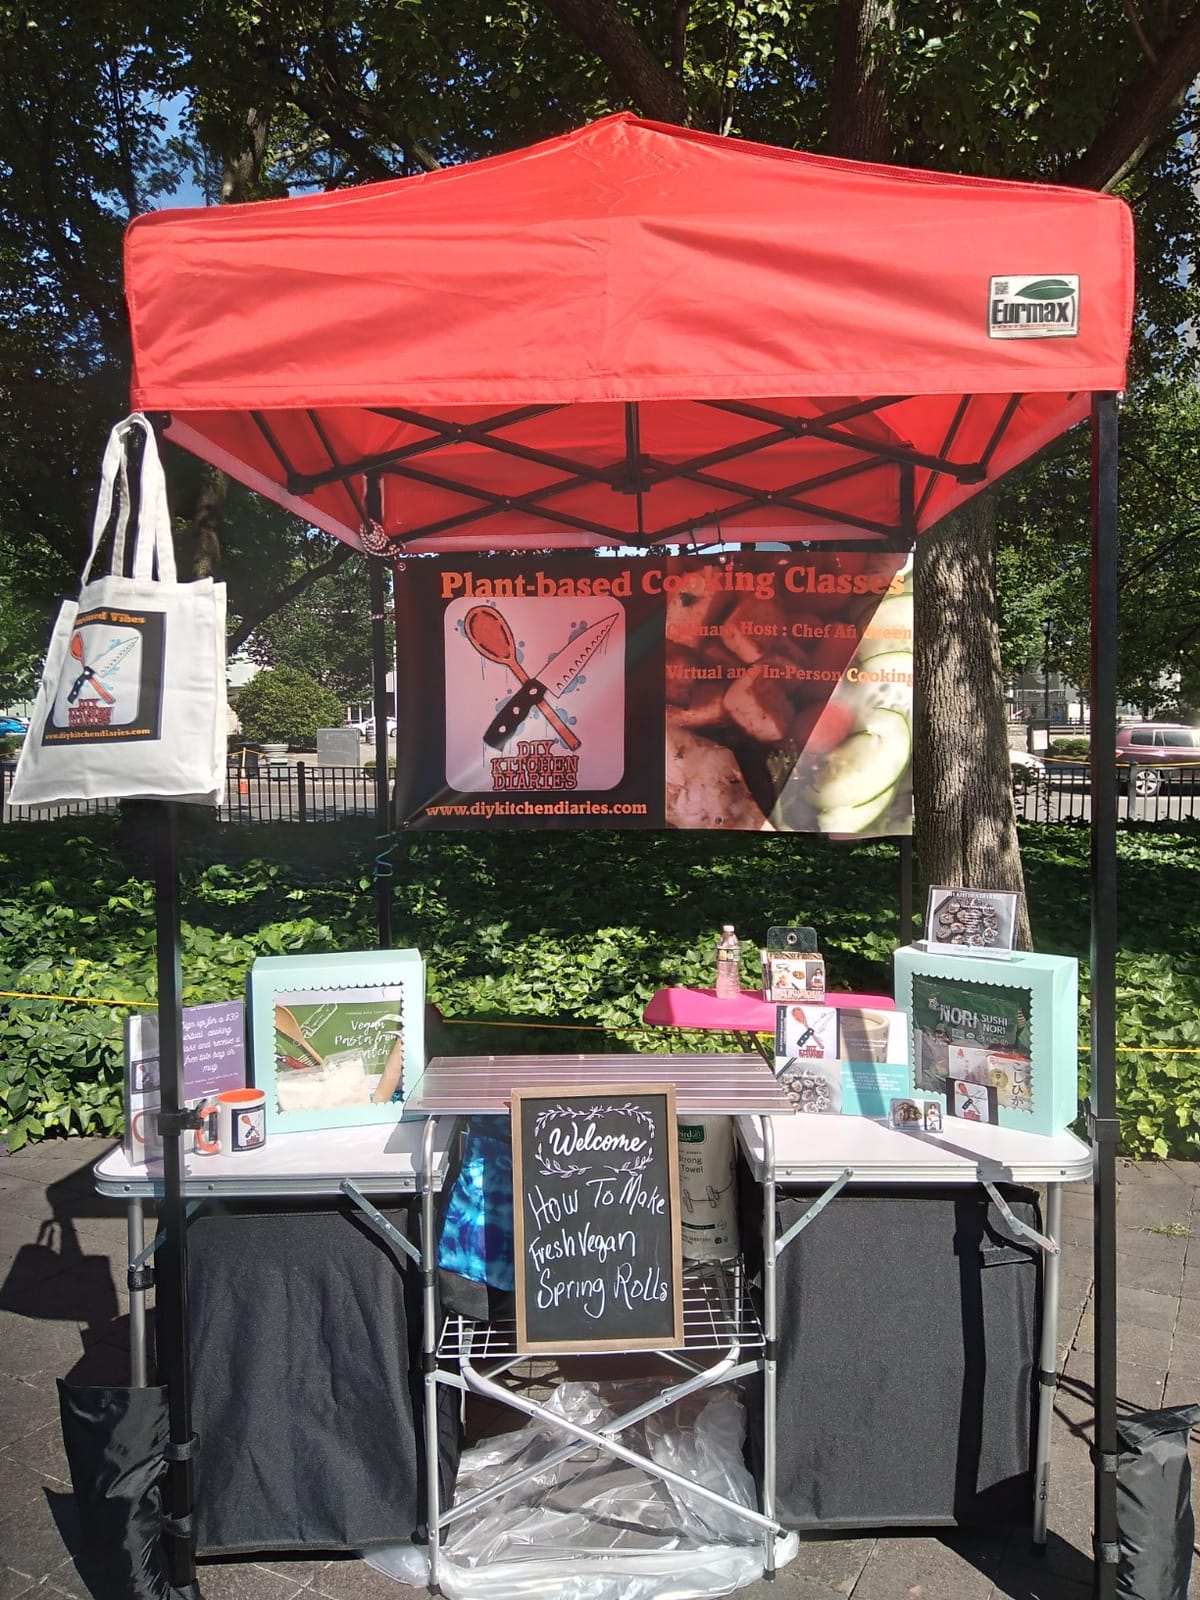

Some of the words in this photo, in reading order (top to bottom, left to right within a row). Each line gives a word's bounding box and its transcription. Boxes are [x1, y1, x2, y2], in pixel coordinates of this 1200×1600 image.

[991, 299, 1070, 325] Eurmax
[441, 570, 632, 598] Plant-based
[641, 564, 776, 600] Cooking
[784, 566, 905, 595] Classes
[740, 621, 779, 637] Host
[791, 623, 832, 638] Chef
[665, 665, 722, 680] Virtual
[727, 664, 756, 680] and
[762, 664, 842, 681] In-Person
[846, 667, 914, 688] Cooking
[517, 739, 555, 757] DIY
[490, 755, 579, 774] KITCHEN
[492, 772, 578, 790] DIARIES
[426, 801, 648, 819] www.diykitchendiaries.com
[351, 1020, 385, 1035] Vegan
[940, 1005, 978, 1029] NORI
[981, 1014, 1008, 1027] SUSHI
[982, 1024, 1006, 1035] NORI
[549, 1122, 648, 1156] Welcome
[586, 1177, 618, 1209] To
[619, 1174, 665, 1215] Make
[529, 1229, 575, 1272] Fresh
[578, 1222, 636, 1264] Vegan
[537, 1267, 606, 1319] Spring
[614, 1262, 668, 1310] Rolls
